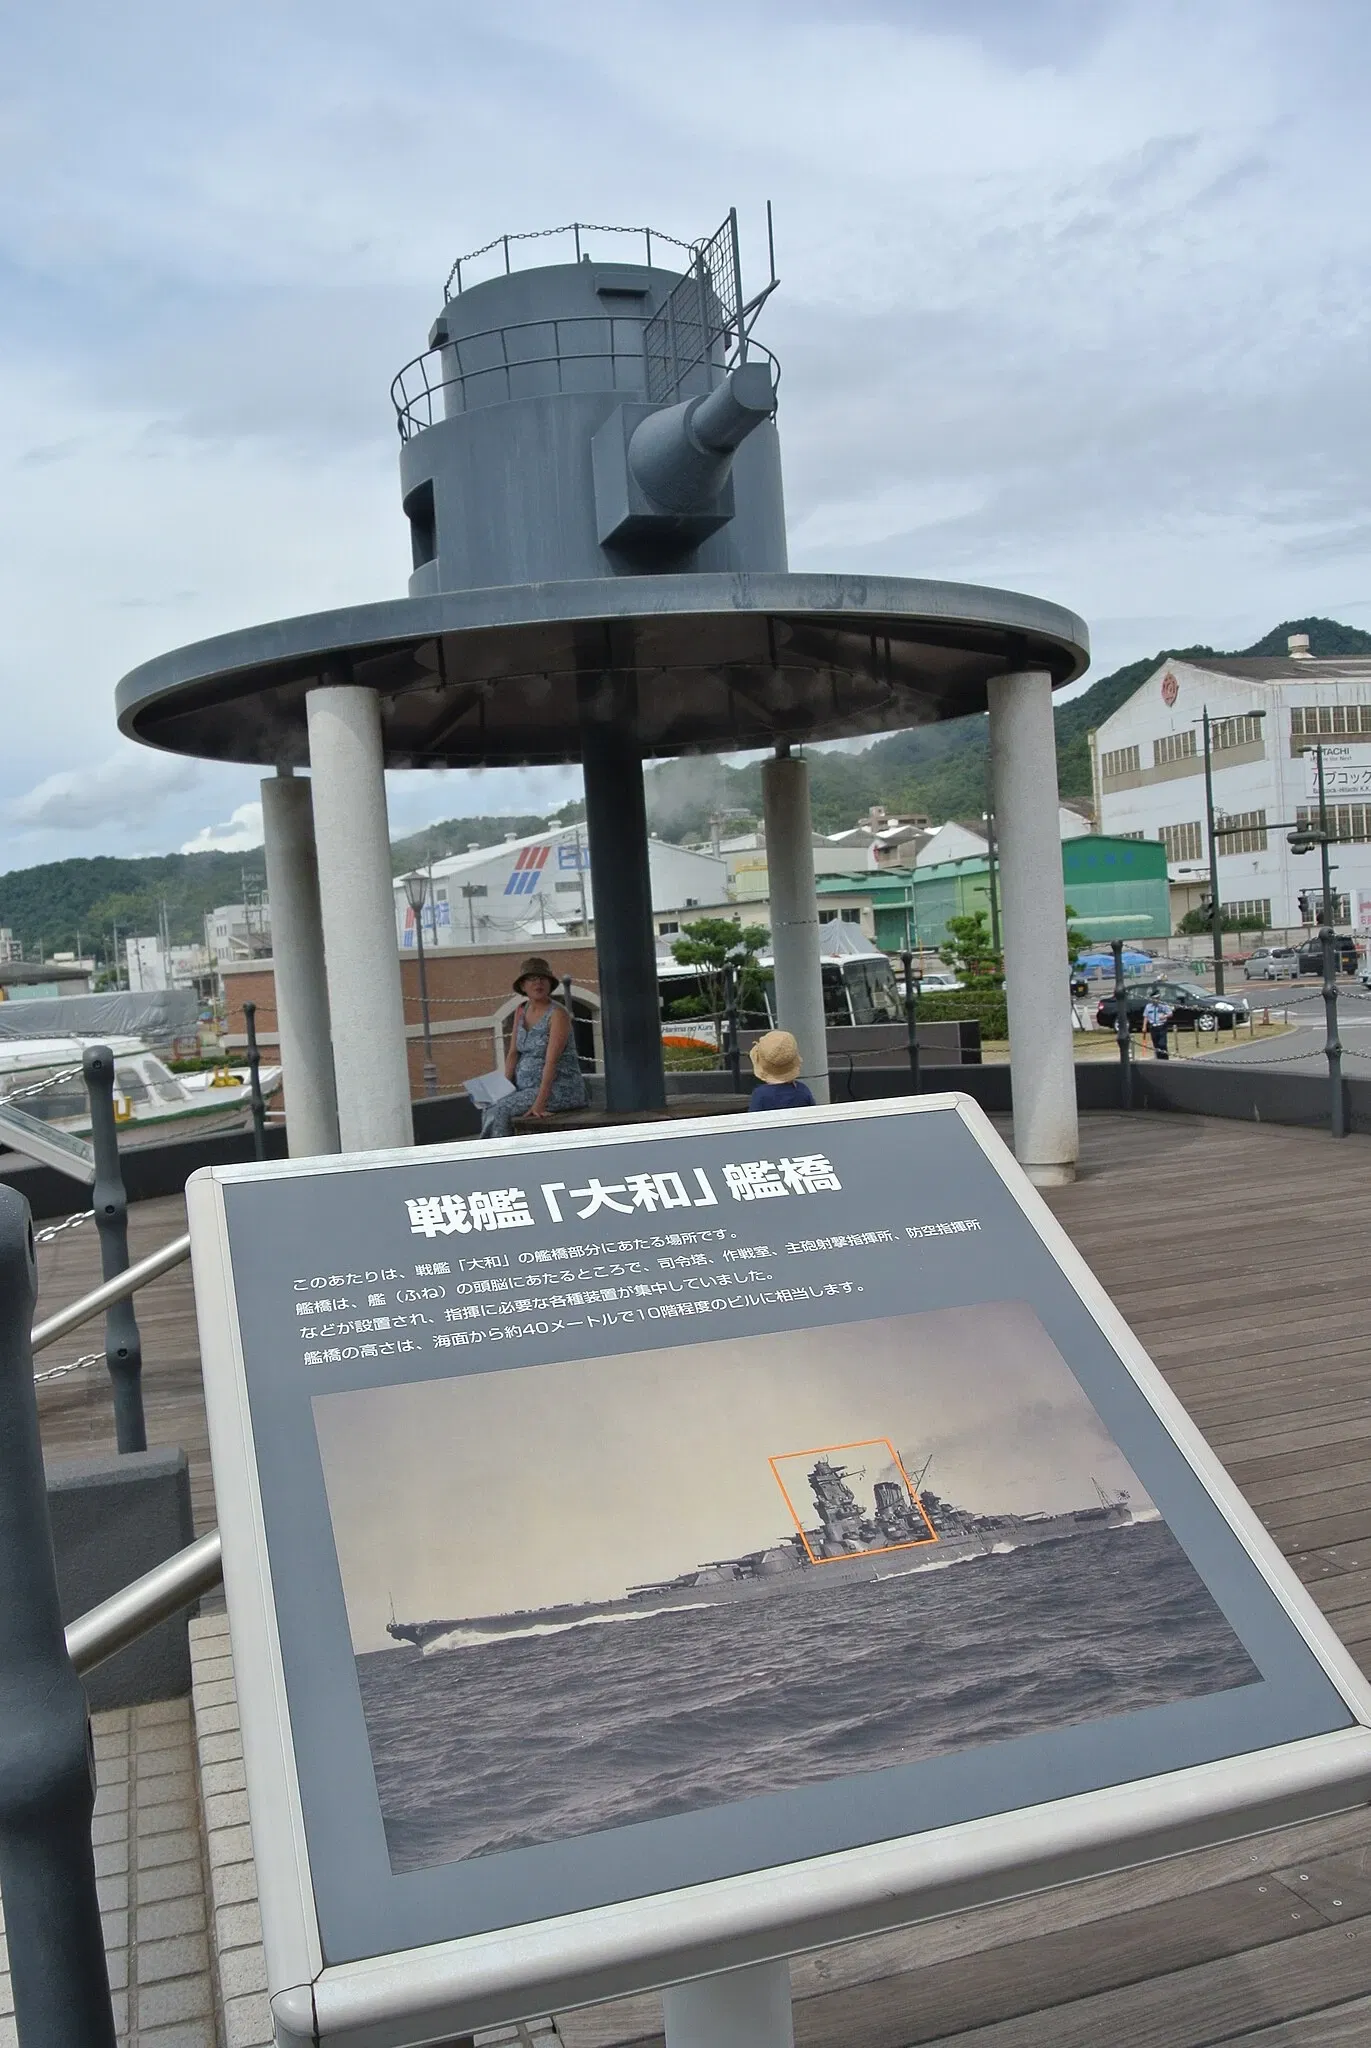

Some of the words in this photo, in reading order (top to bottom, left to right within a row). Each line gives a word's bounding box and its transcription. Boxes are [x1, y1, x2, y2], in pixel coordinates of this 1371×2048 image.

[1311, 747, 1350, 756] TACHI
[662, 1025, 686, 1033] Harima
[407, 1153, 841, 1237] 戦艦「大和」艦橋
